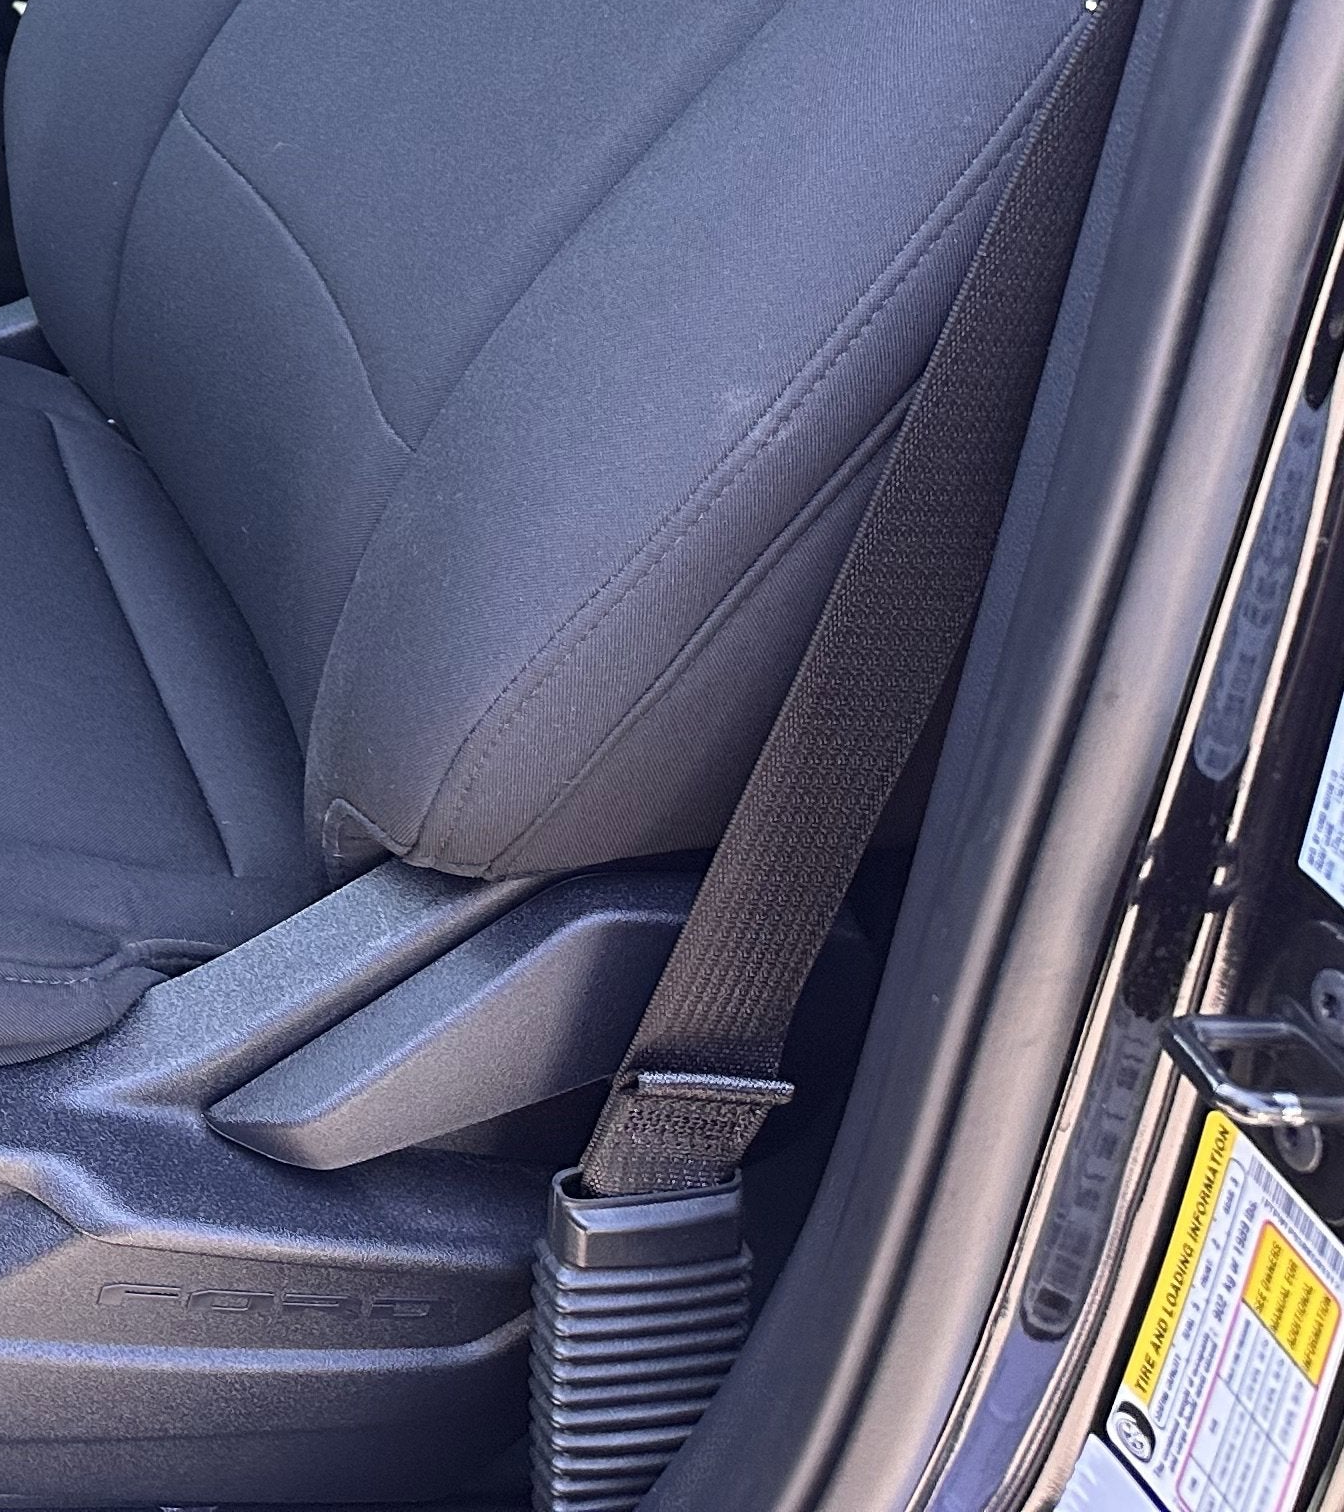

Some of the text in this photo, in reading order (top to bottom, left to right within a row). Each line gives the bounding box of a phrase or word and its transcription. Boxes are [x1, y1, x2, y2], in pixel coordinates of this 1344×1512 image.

[97, 1281, 460, 1320] FORD
[1134, 1124, 1231, 1397] TIRE AND LOADING INFORMATION
